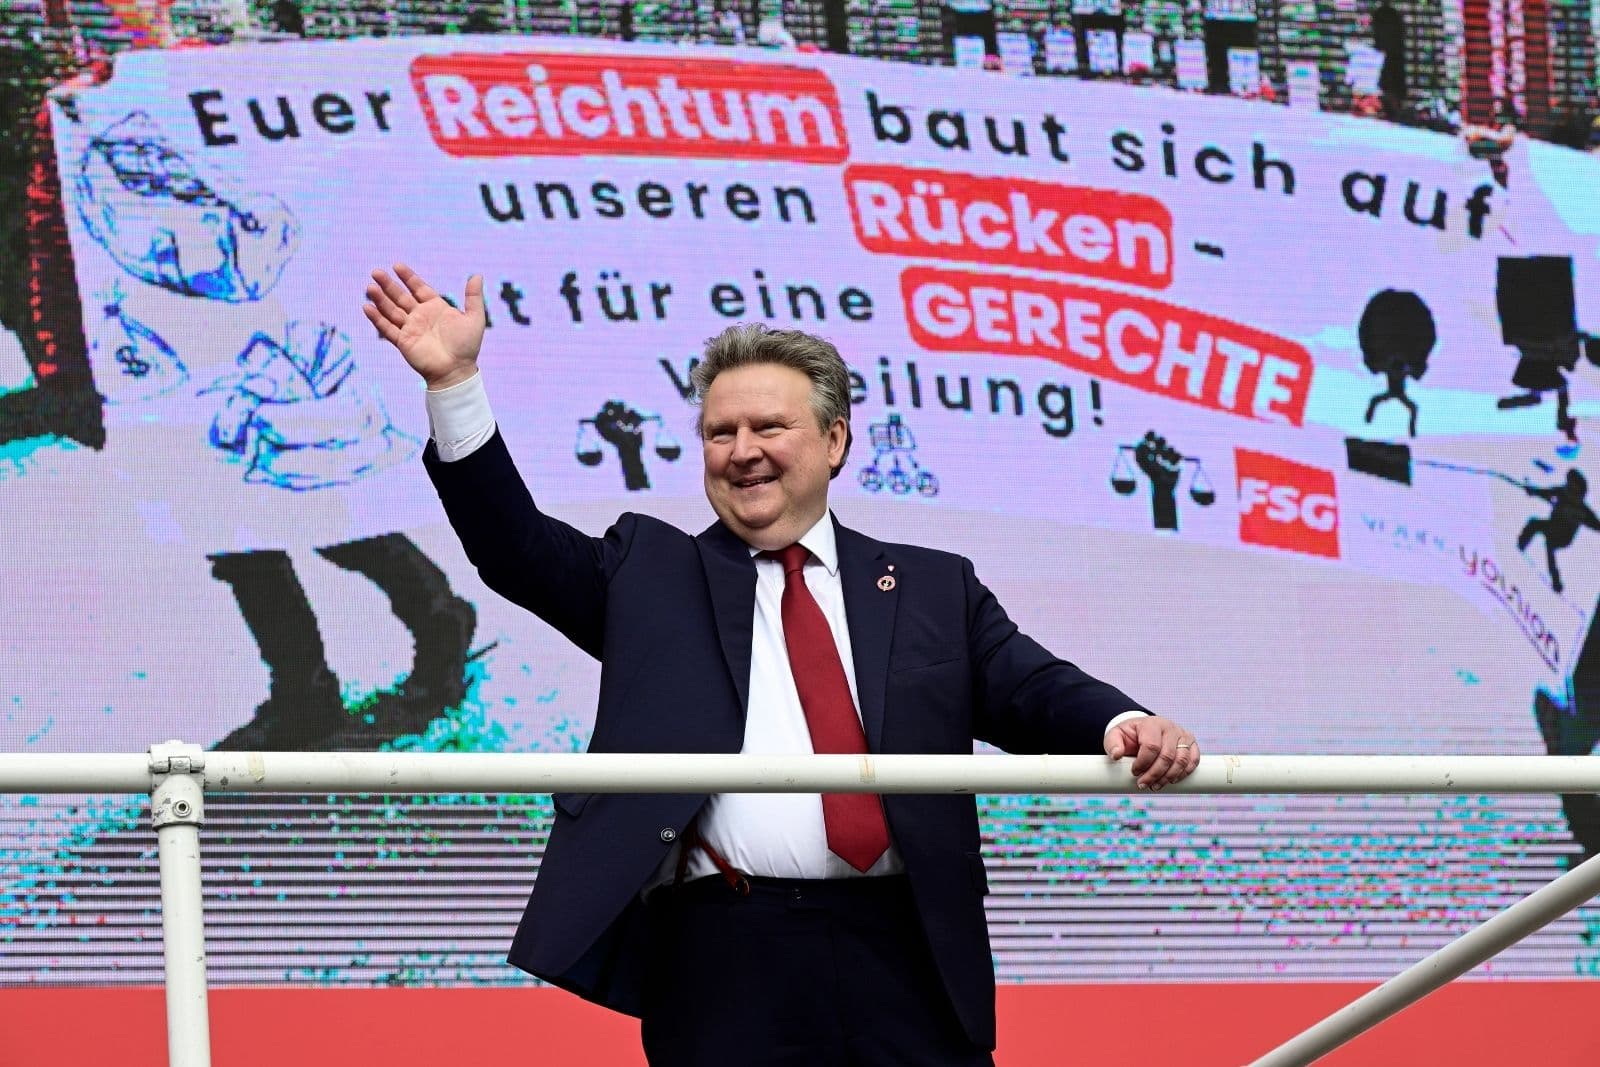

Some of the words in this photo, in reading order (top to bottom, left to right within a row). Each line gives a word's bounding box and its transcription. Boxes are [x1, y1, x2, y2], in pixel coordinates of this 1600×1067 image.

[189, 88, 391, 147] Euer
[421, 65, 839, 149] Reichtum
[865, 90, 1069, 162] baut
[1111, 122, 1296, 195] sich
[1341, 170, 1494, 239] auf
[480, 179, 817, 223] unseren
[849, 179, 1170, 276] Rücken
[560, 270, 672, 323] für
[711, 268, 873, 321] eine
[910, 283, 1303, 425] GERECHTE
[659, 356, 1104, 438] Veilung!
[1240, 479, 1338, 531] FSG
